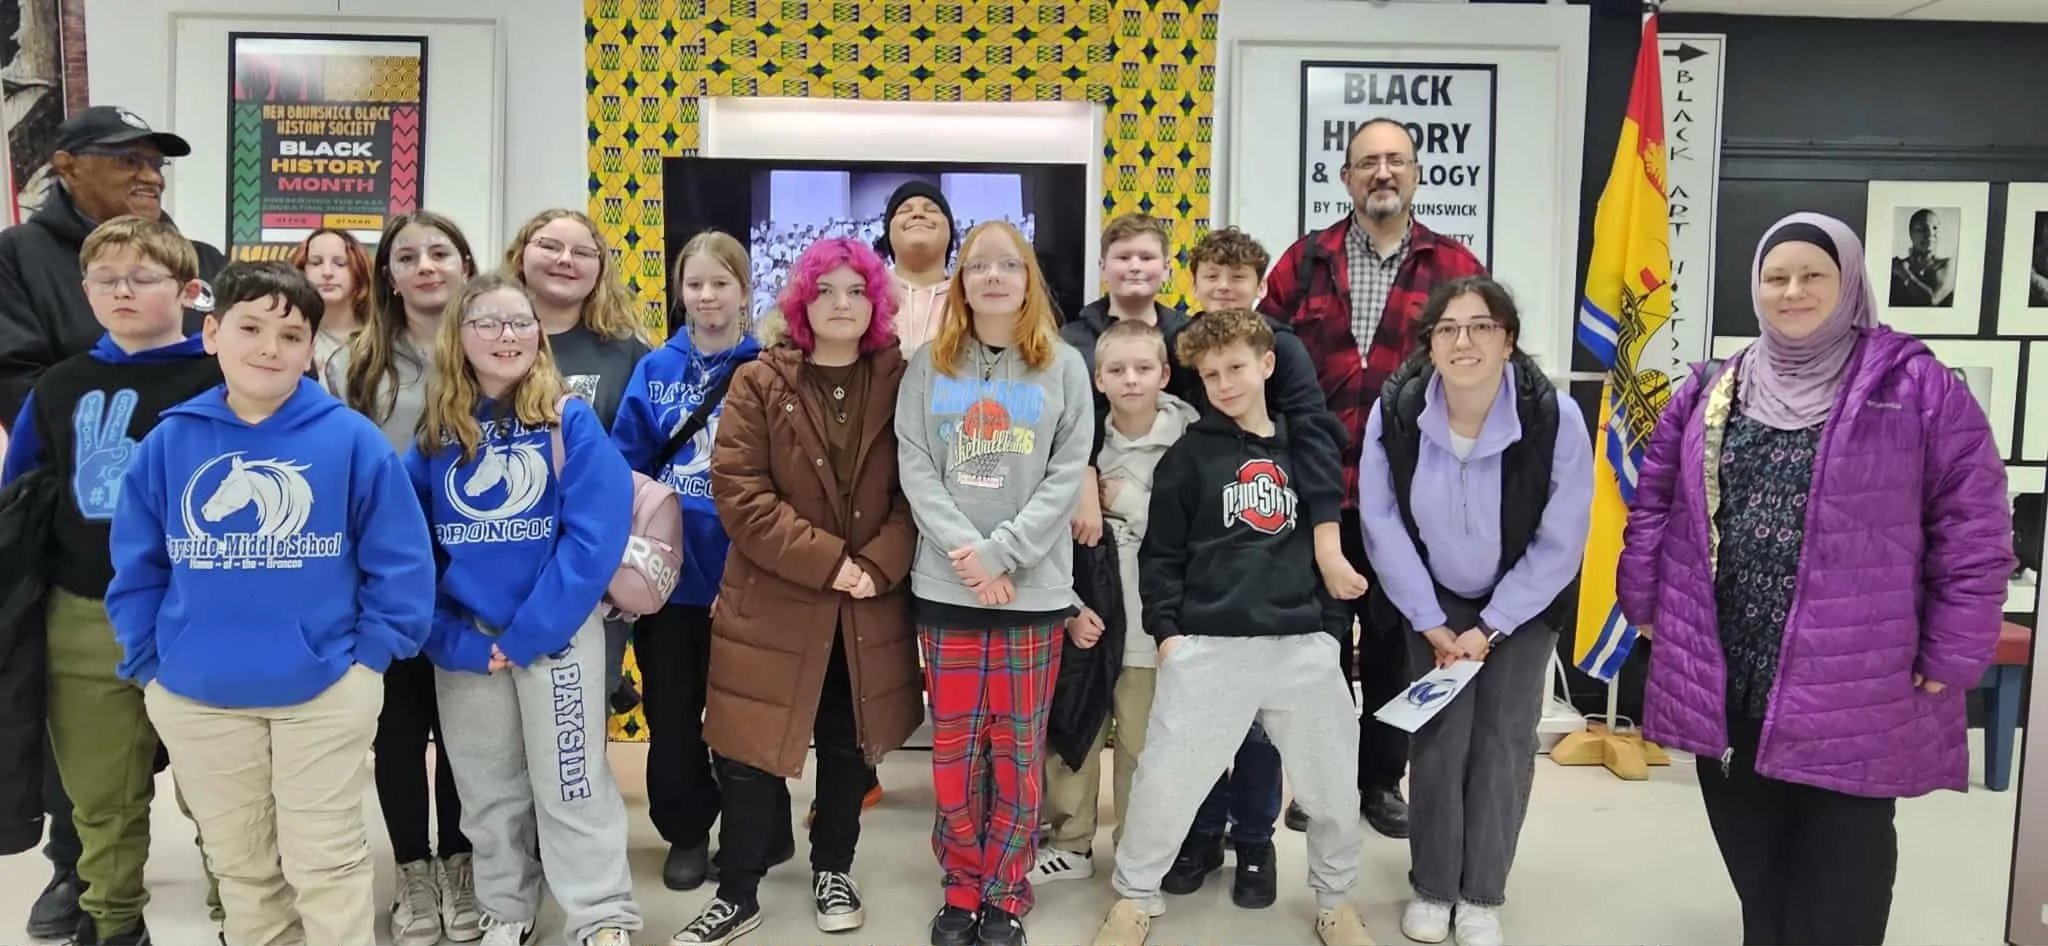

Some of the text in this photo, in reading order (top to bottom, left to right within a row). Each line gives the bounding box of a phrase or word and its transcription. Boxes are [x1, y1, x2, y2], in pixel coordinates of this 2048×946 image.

[1343, 73, 1453, 106] BLACK
[287, 104, 351, 120] BRUNSWICK
[354, 106, 390, 121] BLACK
[1670, 69, 1695, 161] BLACK
[277, 119, 376, 137] HISTORY SOCIETY
[1323, 120, 1472, 154] HIORY
[279, 140, 373, 157] BLACK
[271, 158, 383, 174] HISTORY
[1312, 162, 1329, 184] &
[278, 178, 375, 193] MONTH
[1313, 201, 1330, 214] BY
[1336, 202, 1352, 214] TH
[1669, 185, 1690, 238] ART
[1013, 427, 1035, 455] 76
[286, 532, 342, 558] School
[551, 663, 592, 801] BAYSIDE
